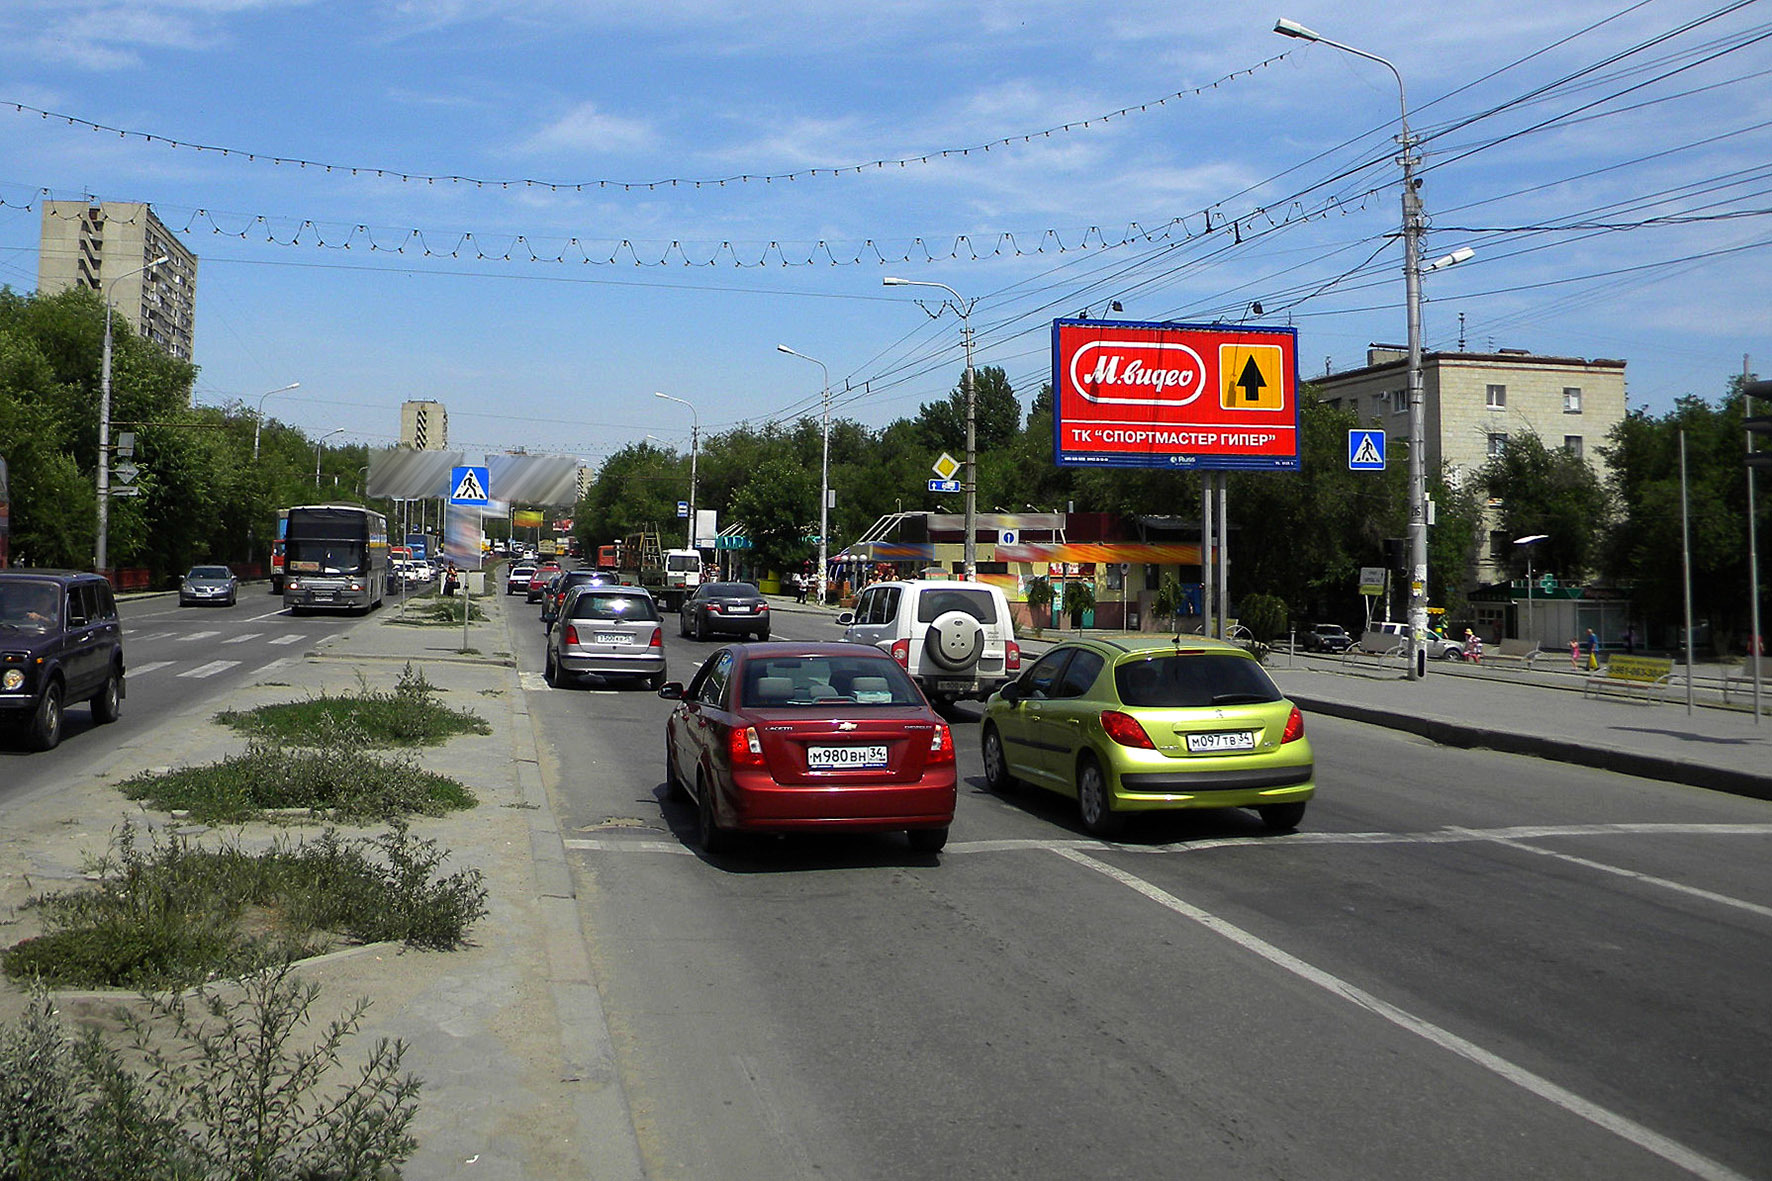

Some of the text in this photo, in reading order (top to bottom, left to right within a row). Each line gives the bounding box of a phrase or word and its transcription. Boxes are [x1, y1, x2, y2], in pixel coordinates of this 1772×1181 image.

[1083, 355, 1194, 392] М.видео
[1071, 429, 1276, 446] ТК “СПОРТМАСТЕР ГИПЕР”
[869, 747, 883, 758] 34
